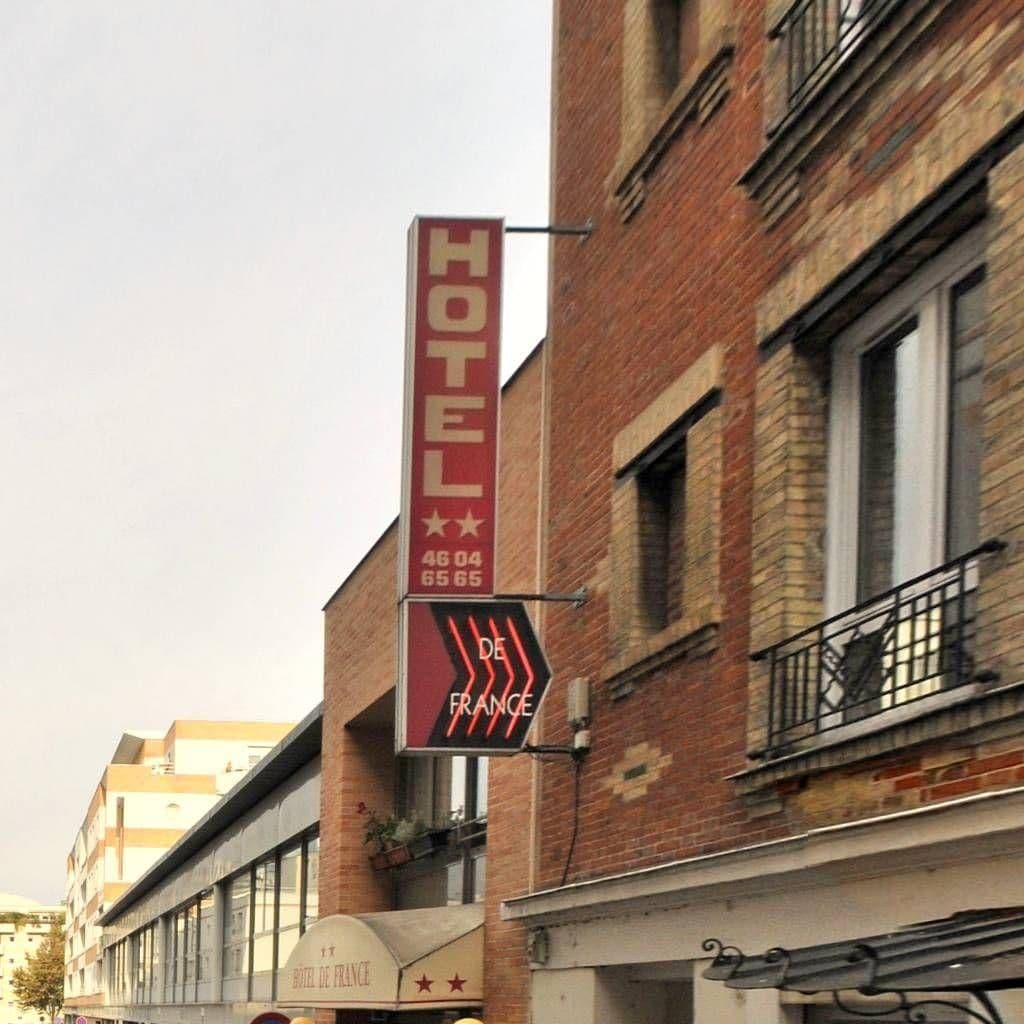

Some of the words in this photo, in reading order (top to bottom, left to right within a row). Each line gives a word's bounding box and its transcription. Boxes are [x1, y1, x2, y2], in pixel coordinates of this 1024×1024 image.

[423, 227, 489, 497] HOTEL
[421, 550, 449, 567] 46
[454, 550, 482, 568] 04
[421, 570, 449, 586] 65
[454, 570, 482, 587] 65
[479, 637, 506, 660] DE
[449, 692, 534, 717] FRANCE
[319, 966, 330, 989] DE
[334, 961, 370, 988] FRANCE
